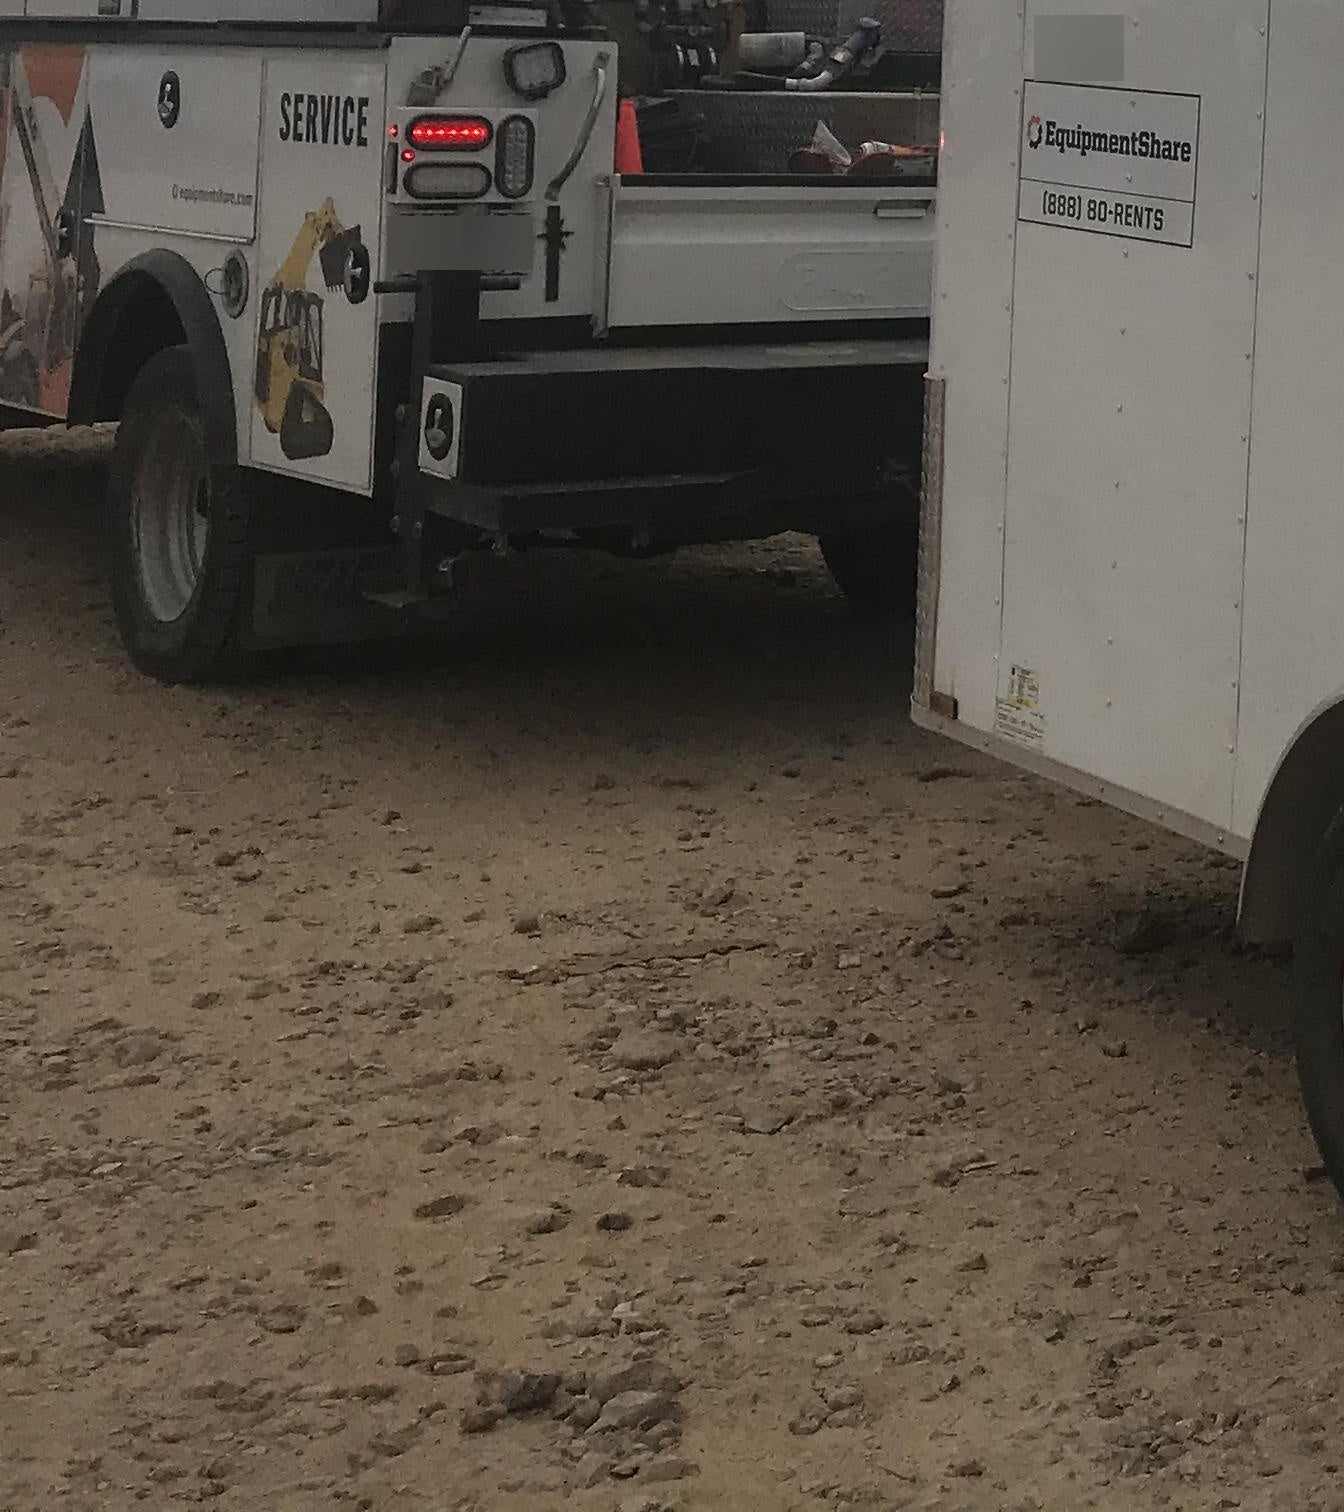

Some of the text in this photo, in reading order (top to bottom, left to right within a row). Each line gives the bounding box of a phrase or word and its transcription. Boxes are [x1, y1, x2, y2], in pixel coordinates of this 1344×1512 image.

[278, 91, 370, 147] SERVICE
[1044, 120, 1192, 163] EquipmentShare
[1042, 190, 1164, 231] (888) 80-RENTS
